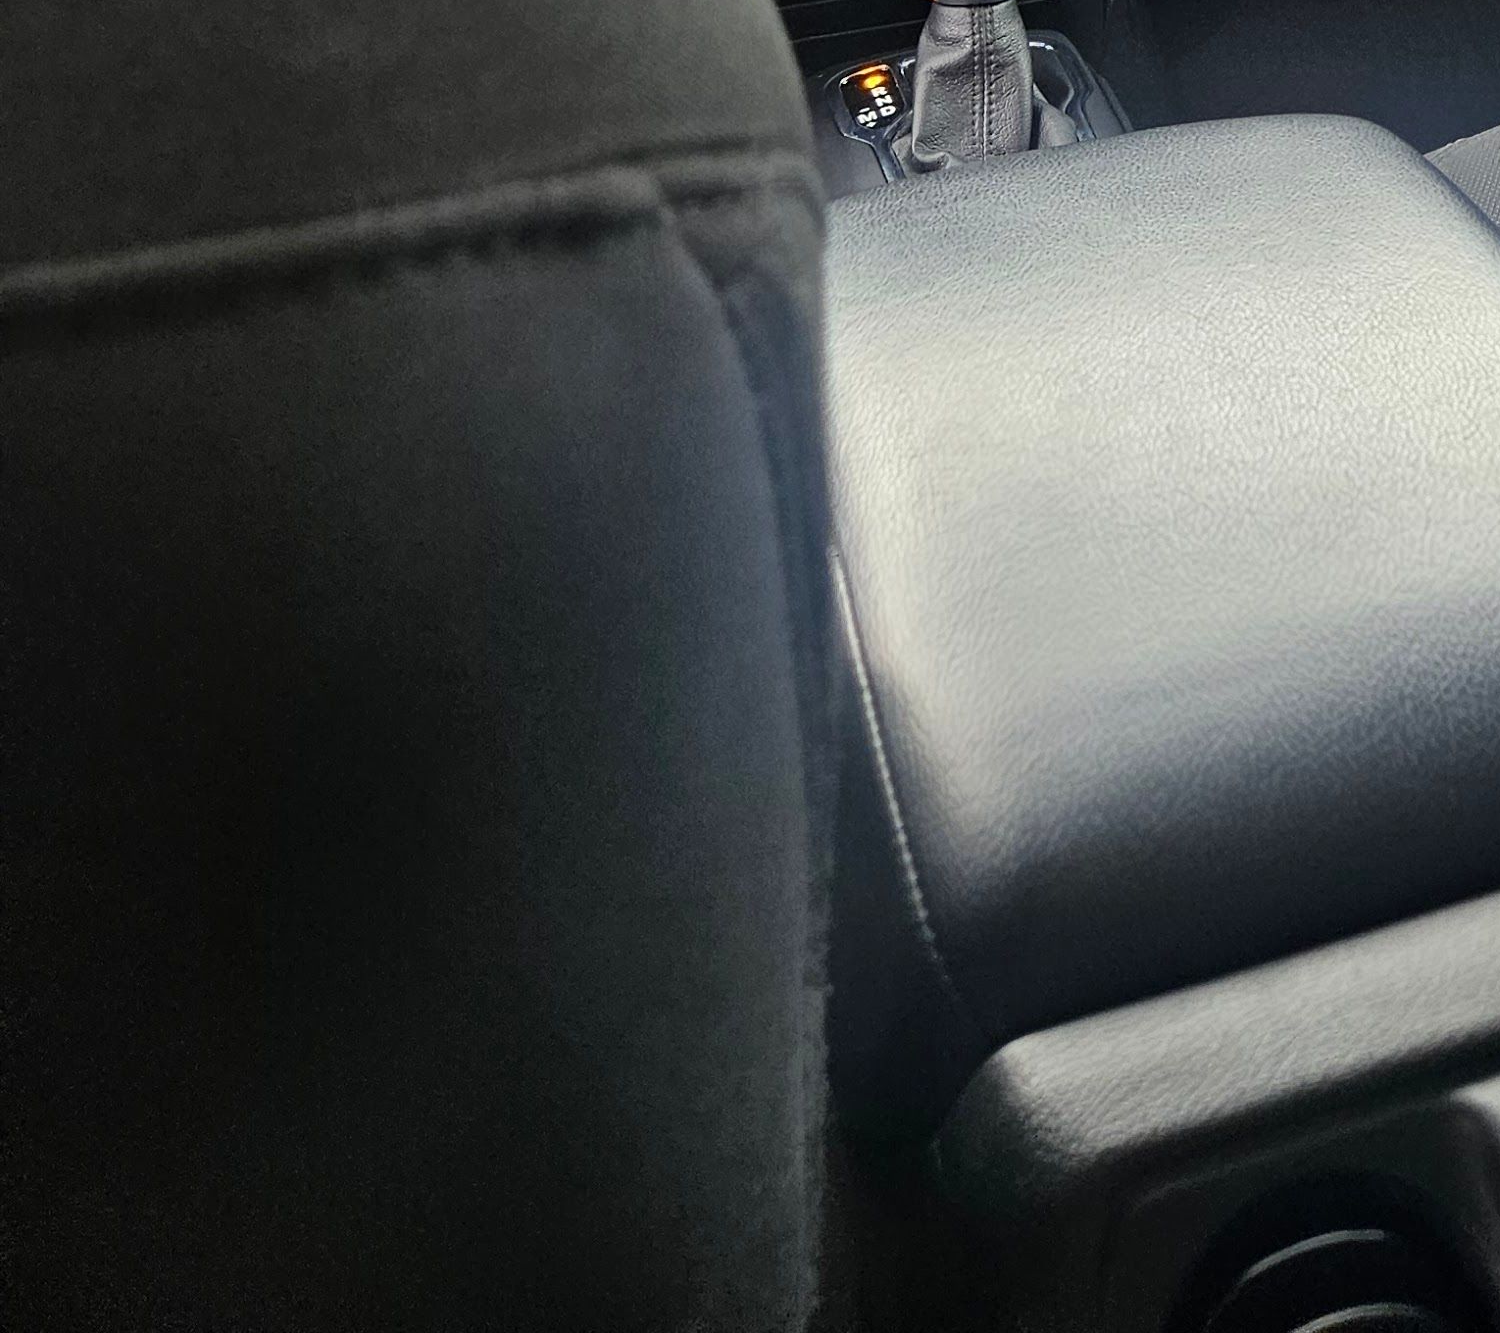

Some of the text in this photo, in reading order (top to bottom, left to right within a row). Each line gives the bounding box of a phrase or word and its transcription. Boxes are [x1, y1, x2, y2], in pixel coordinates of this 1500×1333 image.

[875, 94, 893, 107] N
[857, 110, 878, 124] M
[880, 105, 897, 117] D
